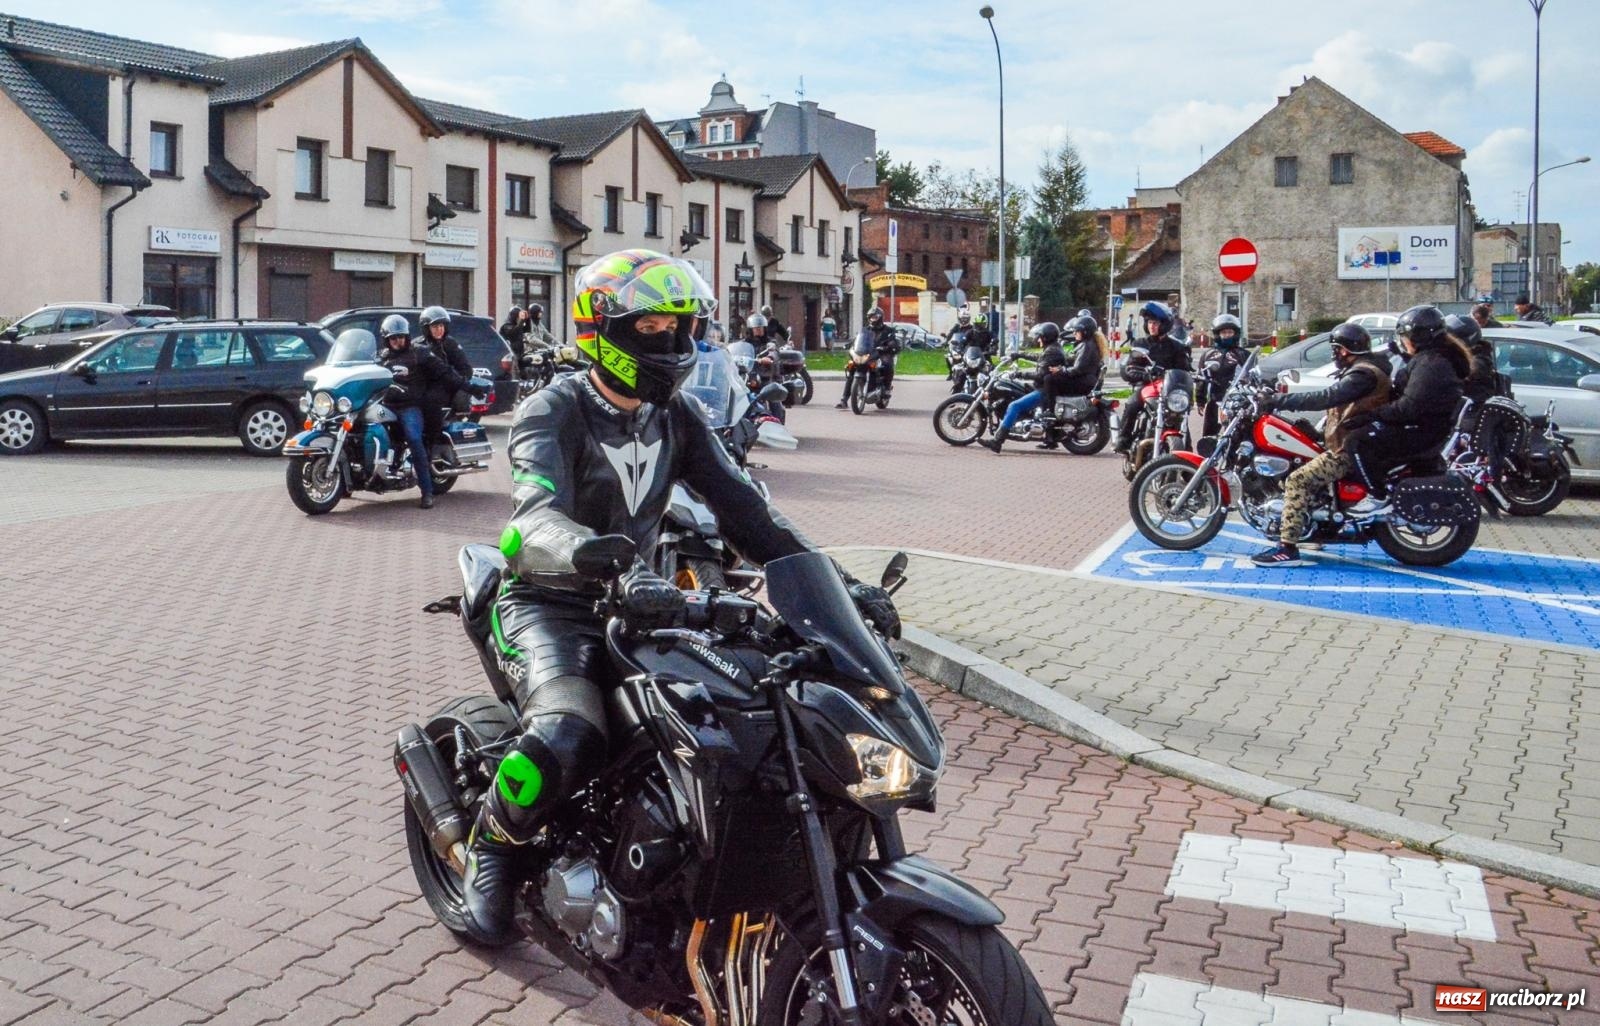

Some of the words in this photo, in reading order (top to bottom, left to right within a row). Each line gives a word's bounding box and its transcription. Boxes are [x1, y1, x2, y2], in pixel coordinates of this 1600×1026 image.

[1410, 235, 1448, 248] Dom
[519, 243, 555, 259] dentica
[689, 641, 740, 679] awasaki
